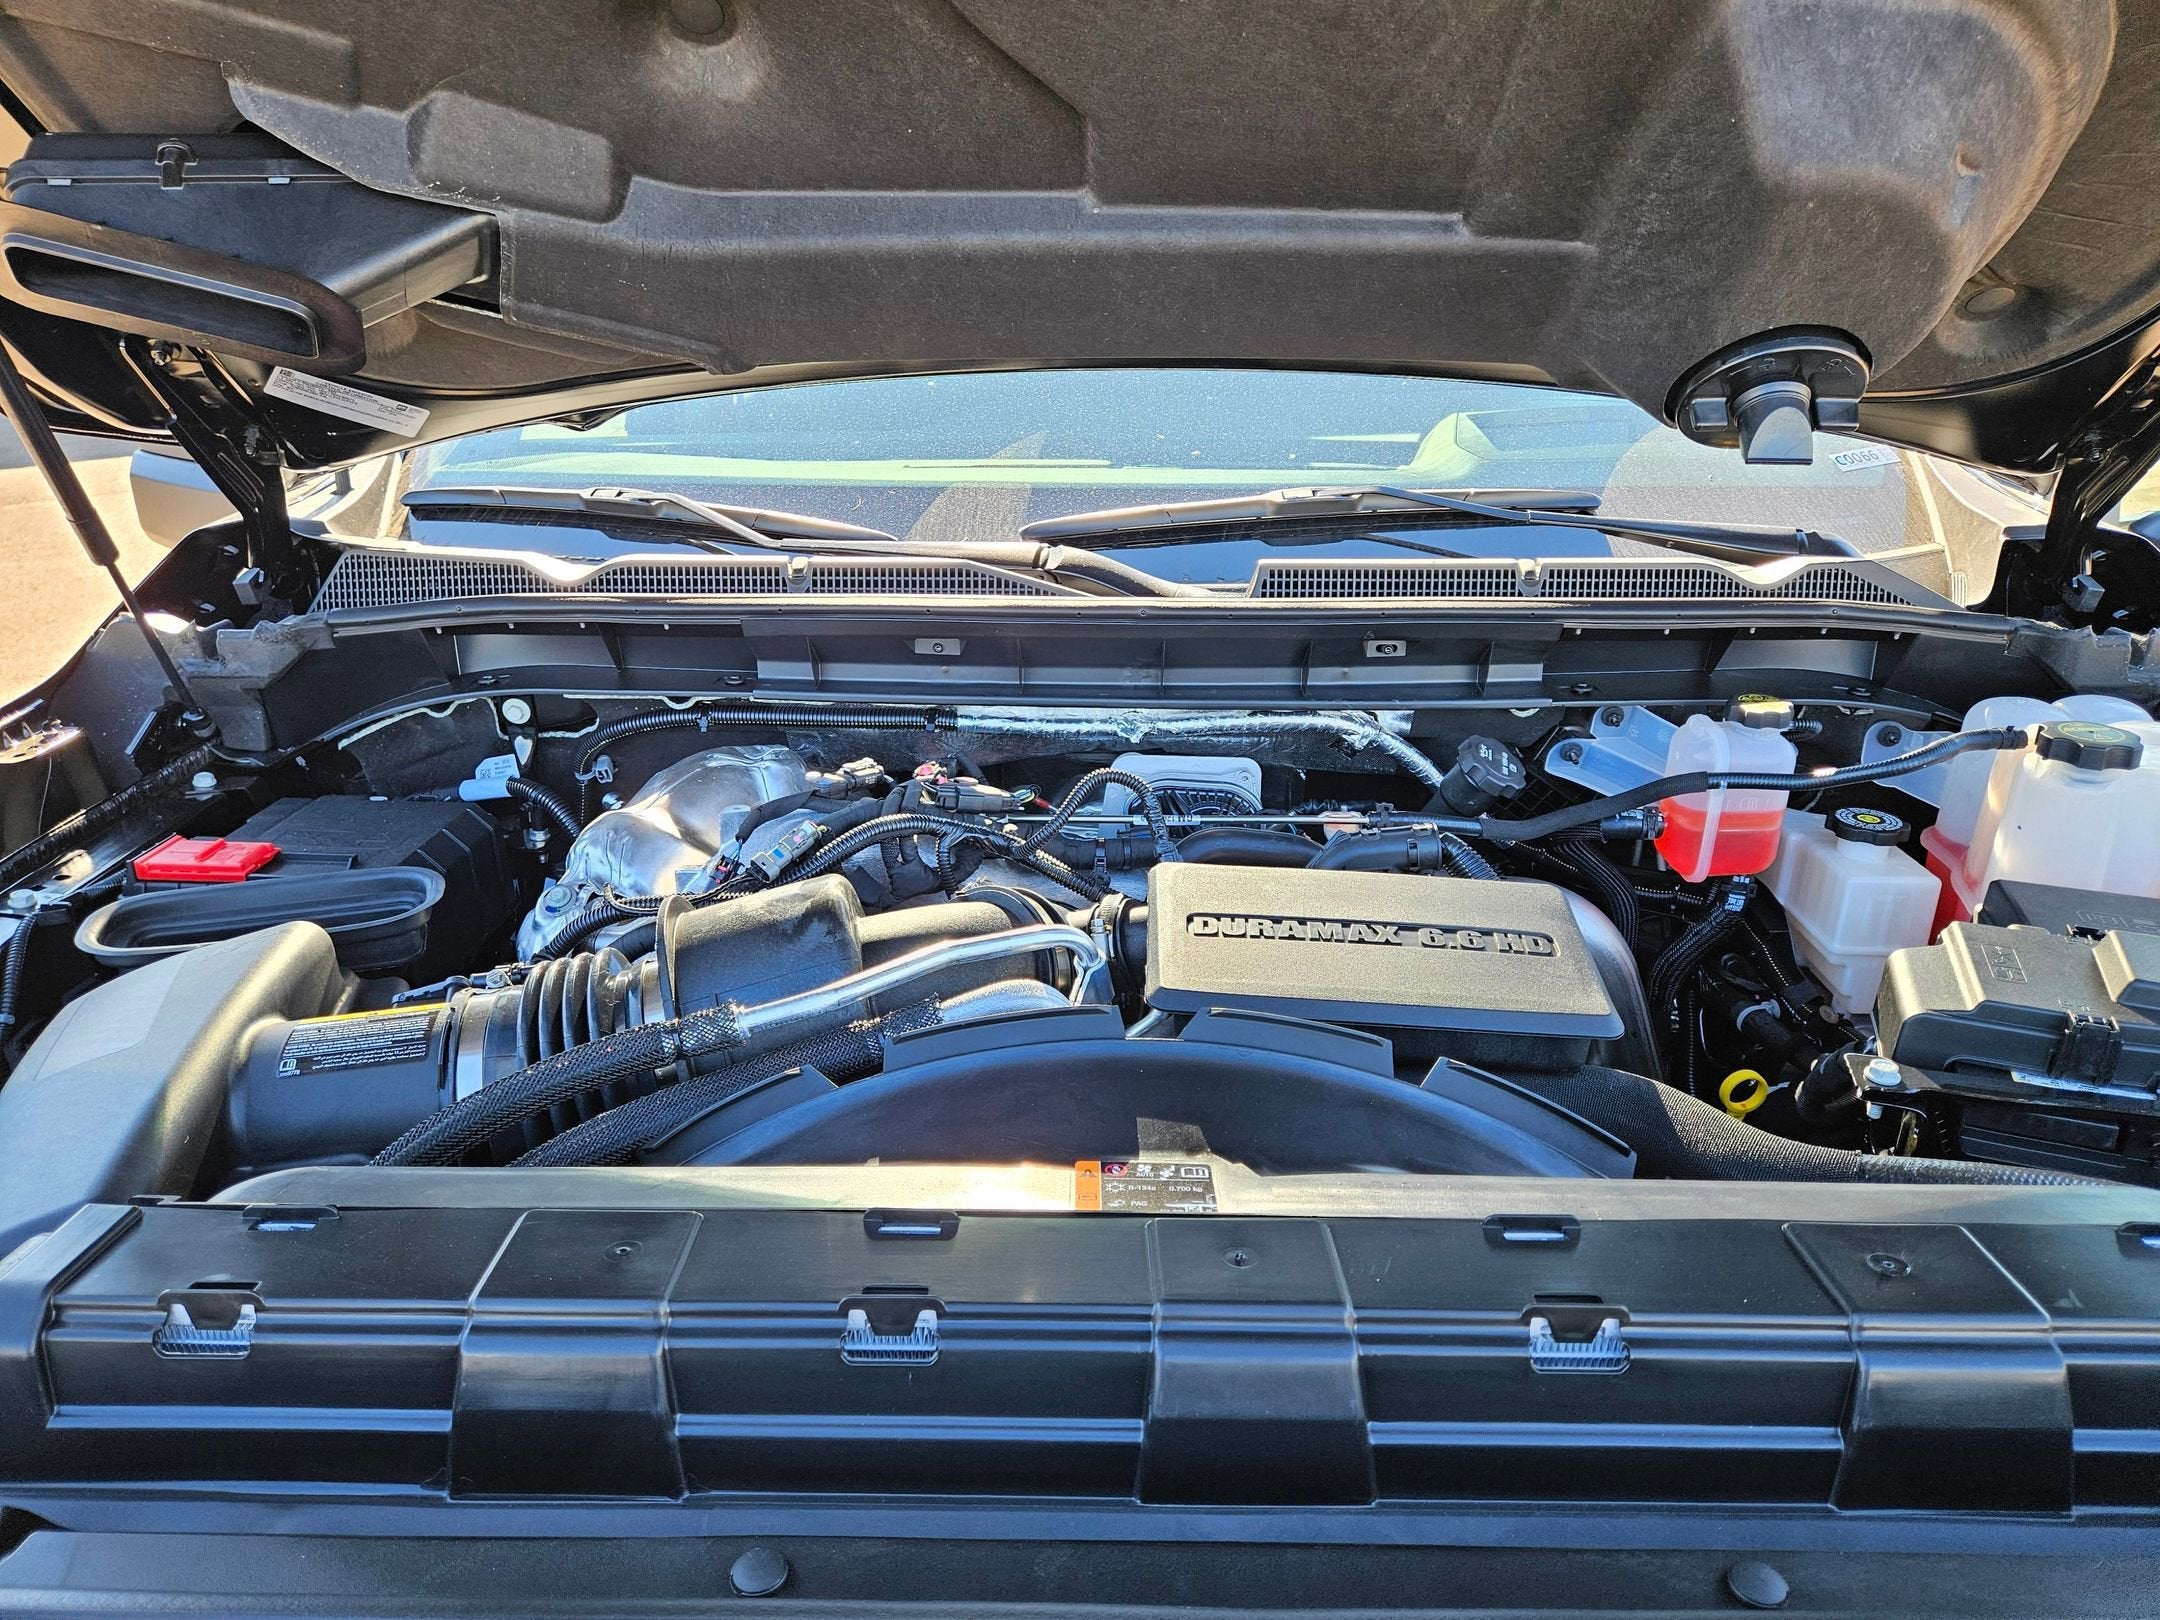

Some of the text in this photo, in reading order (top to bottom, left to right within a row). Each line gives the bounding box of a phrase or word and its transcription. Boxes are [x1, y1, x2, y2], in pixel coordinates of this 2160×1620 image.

[1193, 915, 1555, 955] DURAMAX 6.6 HD
